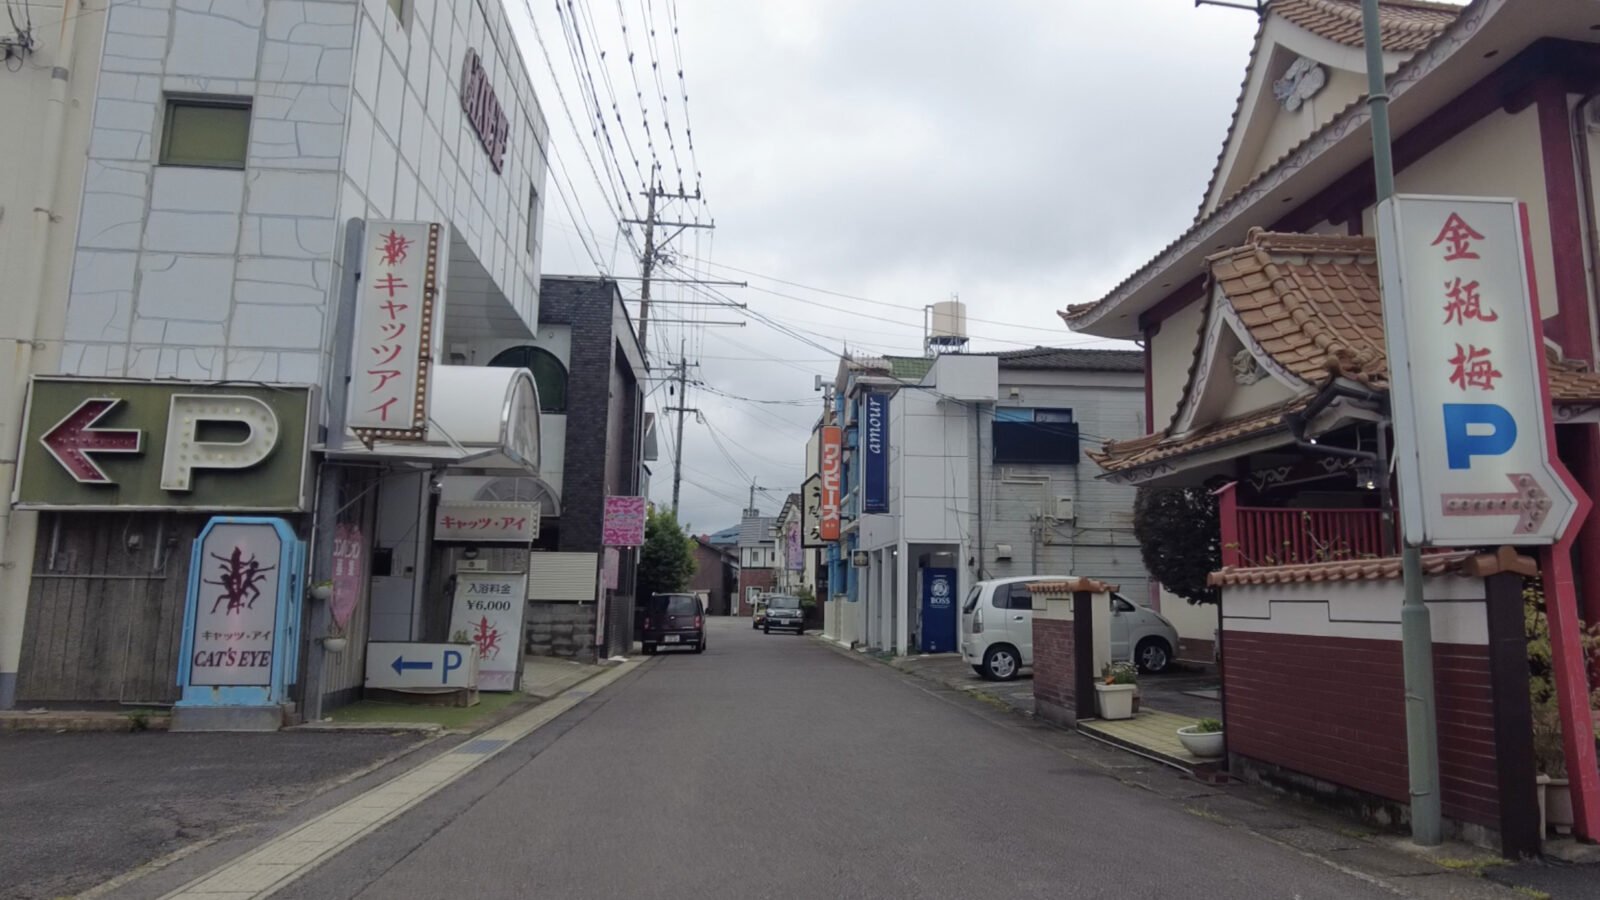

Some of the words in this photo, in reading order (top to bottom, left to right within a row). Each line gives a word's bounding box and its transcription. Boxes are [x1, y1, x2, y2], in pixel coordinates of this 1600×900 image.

[1430, 212, 1503, 391] 金瓶梅
[160, 394, 279, 490] P
[869, 397, 882, 454] amour
[1442, 403, 1517, 470] P
[824, 443, 840, 521] ワンピース
[467, 584, 511, 594] 入浴料金
[930, 597, 951, 605] BOSS
[194, 647, 237, 667] CAT'S
[238, 650, 271, 667] EYE
[442, 650, 462, 684] P
